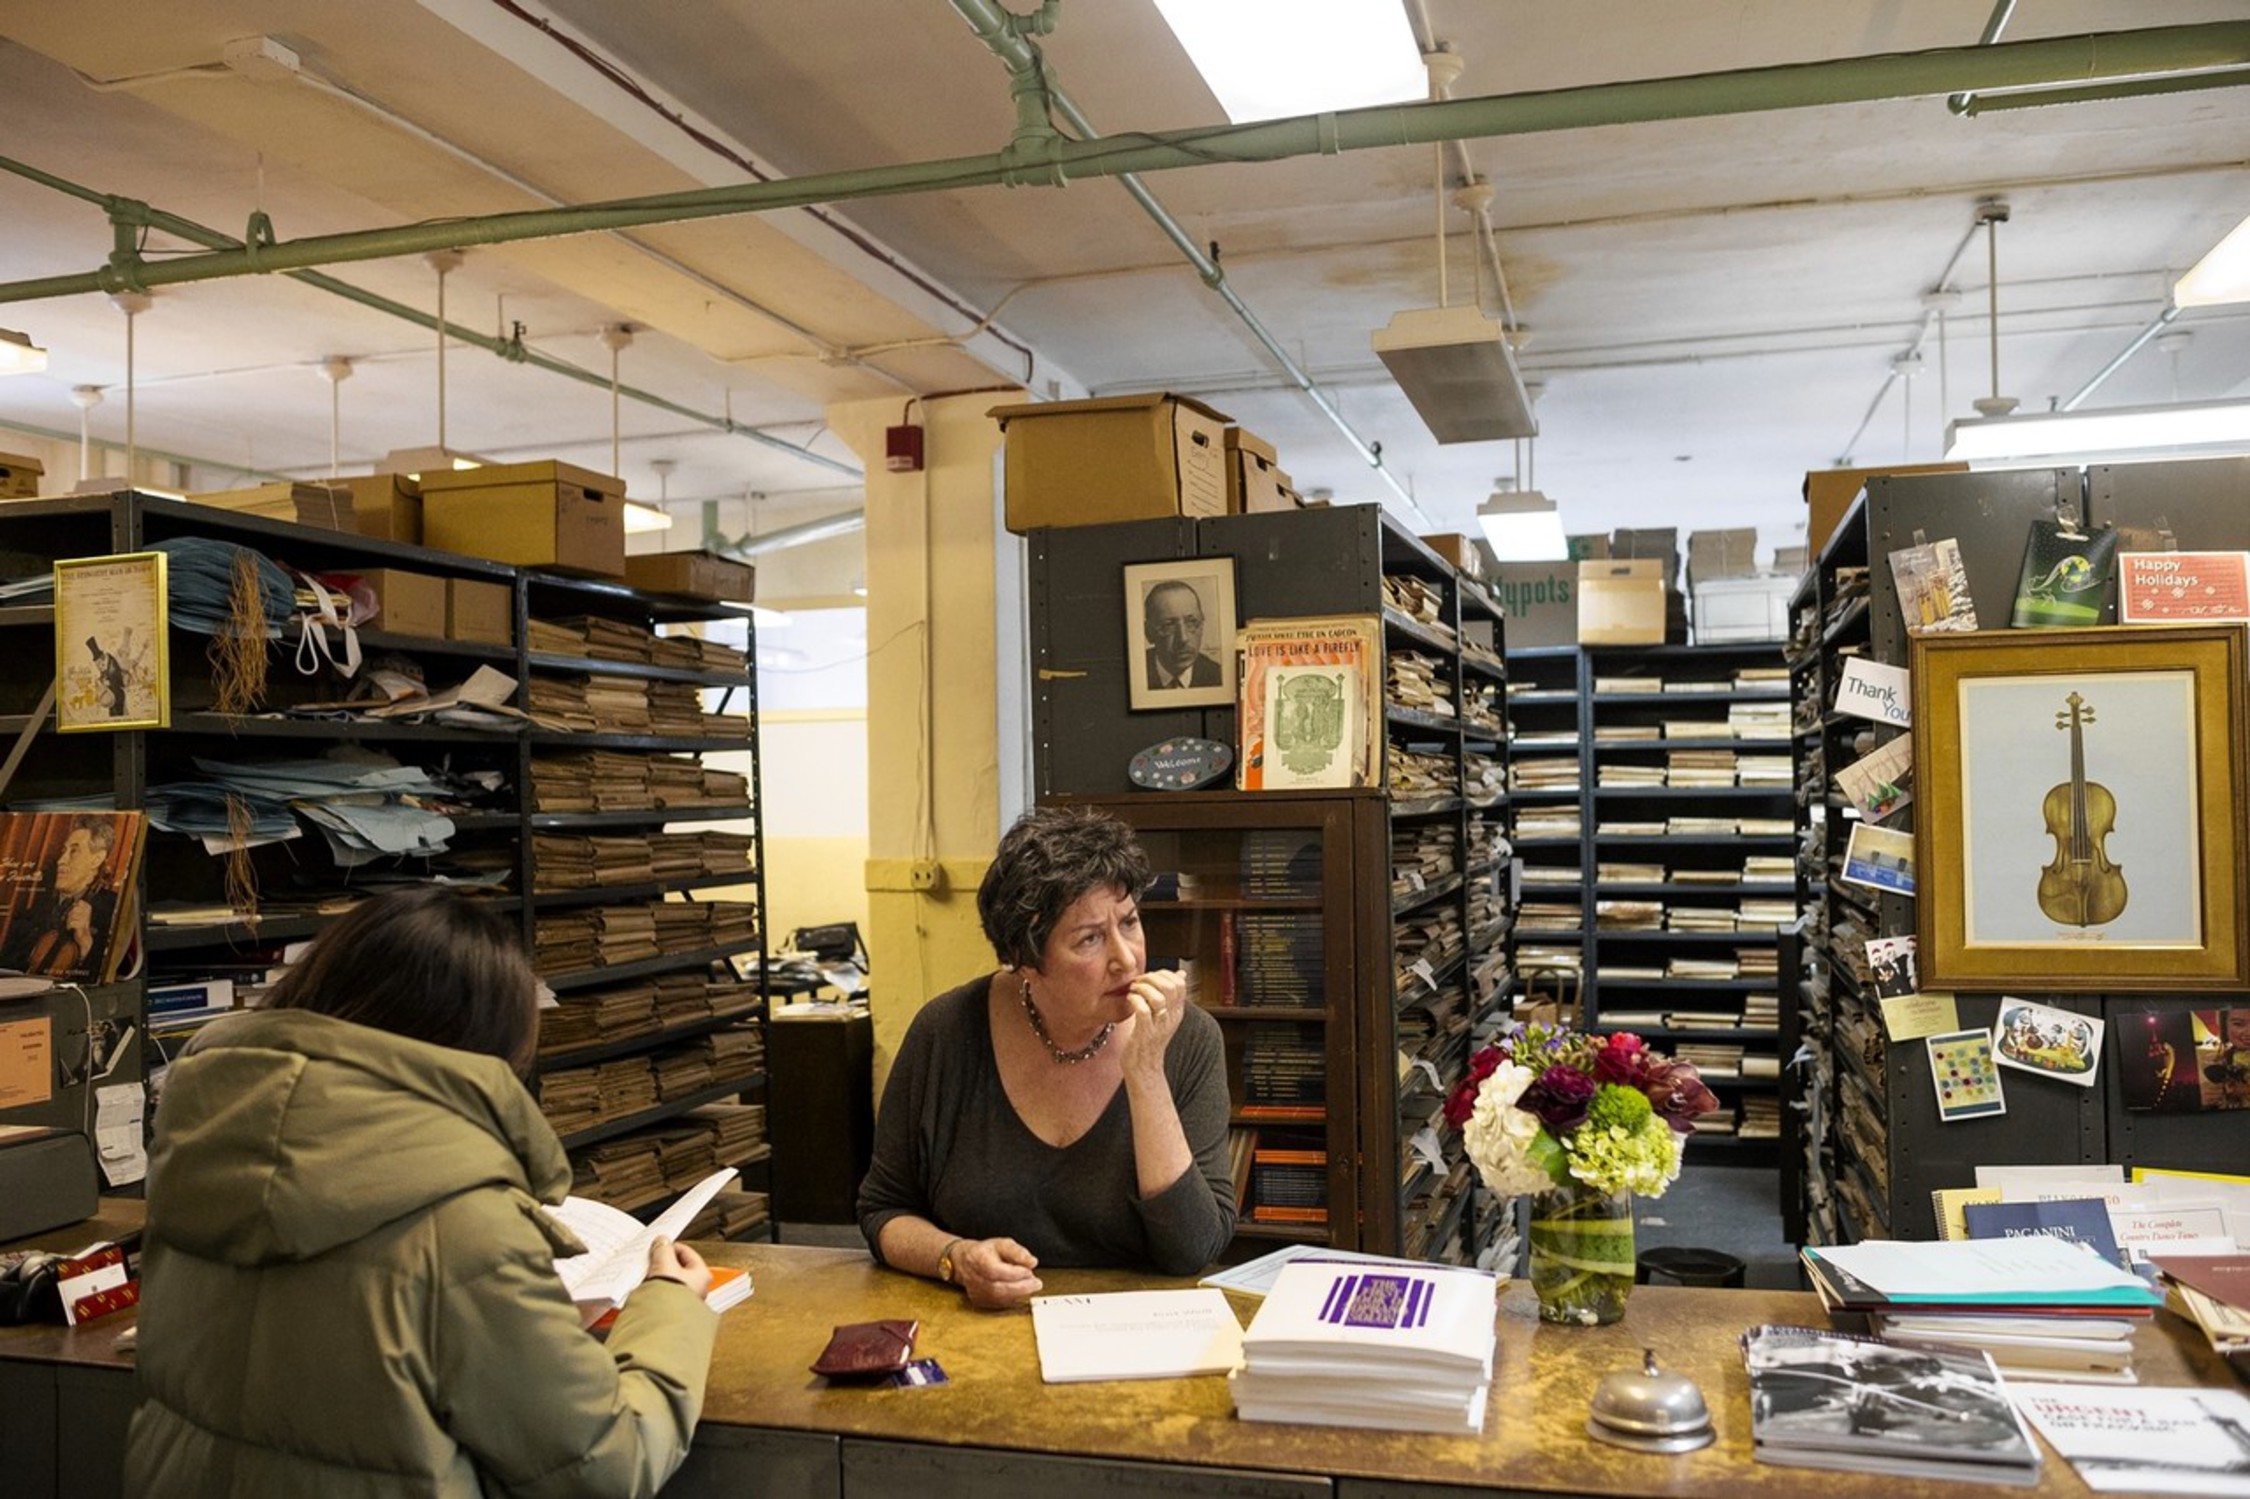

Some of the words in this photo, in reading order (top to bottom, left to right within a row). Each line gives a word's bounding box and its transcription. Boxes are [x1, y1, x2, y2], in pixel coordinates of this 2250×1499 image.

[2133, 559, 2181, 572] Happy
[2134, 574, 2199, 588] Holidays
[1248, 644, 1272, 657] LOVE
[1275, 644, 1286, 657] IS
[1289, 642, 1309, 656] LIKE
[1313, 642, 1320, 655] A
[1323, 640, 1361, 654] FIREFLY
[1847, 676, 1897, 701] Thank
[1883, 699, 1911, 721] You
[1154, 757, 1201, 769] Welcome
[2132, 1220, 2146, 1229] The
[2147, 1219, 2182, 1230] Complete
[2004, 1225, 2076, 1239] PAGANINI
[2120, 1232, 2151, 1242] Country
[2152, 1231, 2177, 1241] Dance
[2177, 1230, 2200, 1240] Tunes
[2033, 1402, 2147, 1418] URGENT
